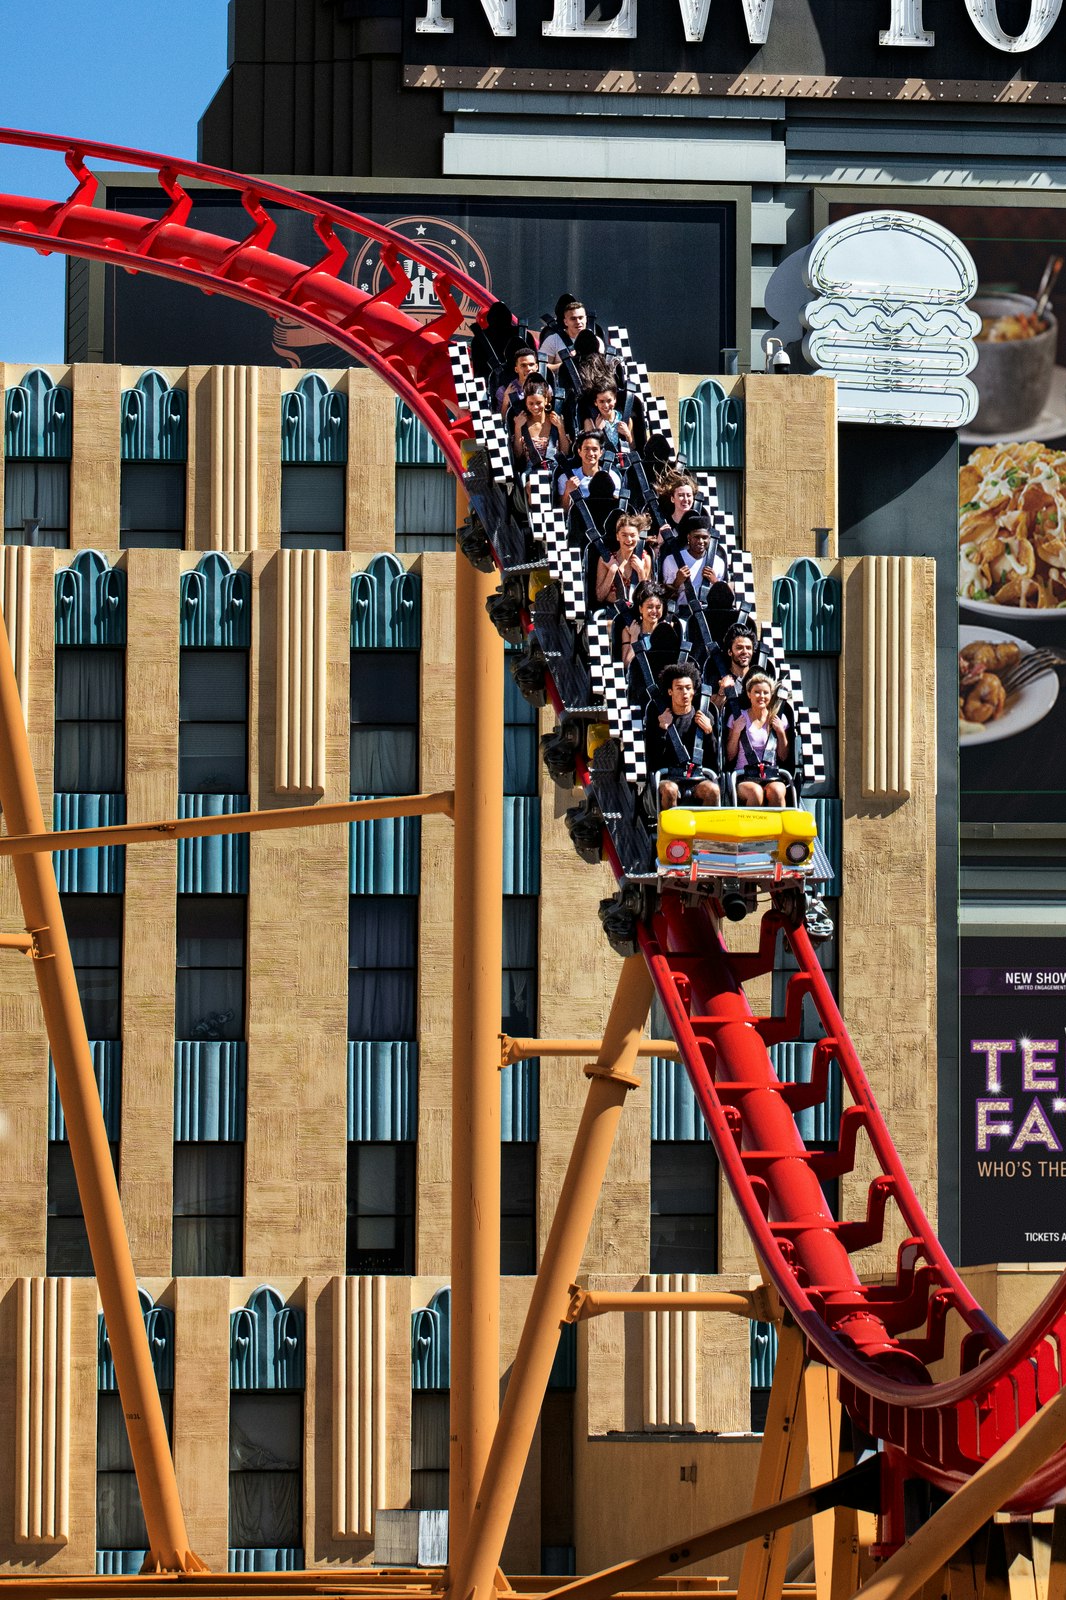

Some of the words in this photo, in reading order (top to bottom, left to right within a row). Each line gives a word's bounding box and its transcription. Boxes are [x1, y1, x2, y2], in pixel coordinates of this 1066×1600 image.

[1005, 972, 1033, 984] NEW
[977, 1161, 1032, 1178] WHO'S
[1024, 1232, 1060, 1242] TICKETS
